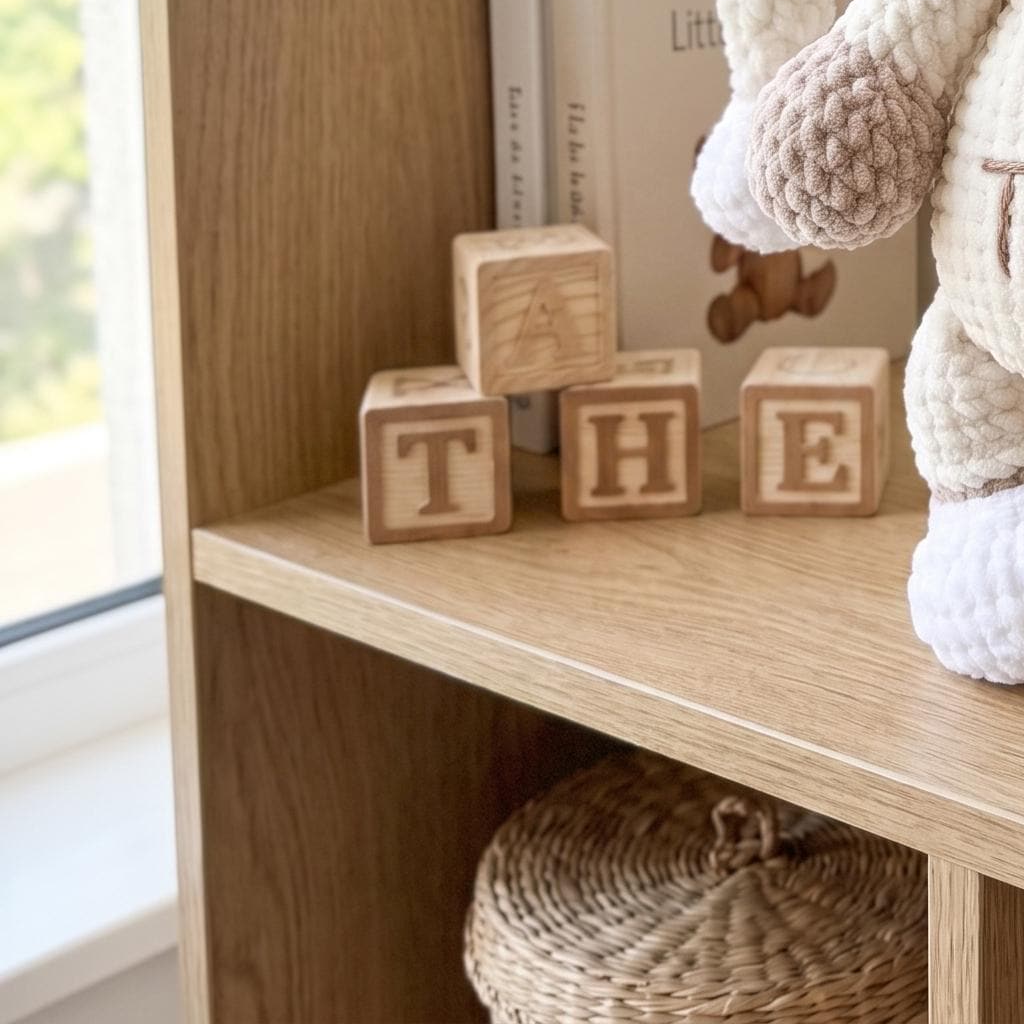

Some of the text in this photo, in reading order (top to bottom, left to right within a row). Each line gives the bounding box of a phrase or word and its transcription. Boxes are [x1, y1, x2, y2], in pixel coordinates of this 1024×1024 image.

[503, 276, 584, 370] A
[397, 428, 477, 515] T
[588, 411, 677, 497] H
[776, 411, 849, 492] E
